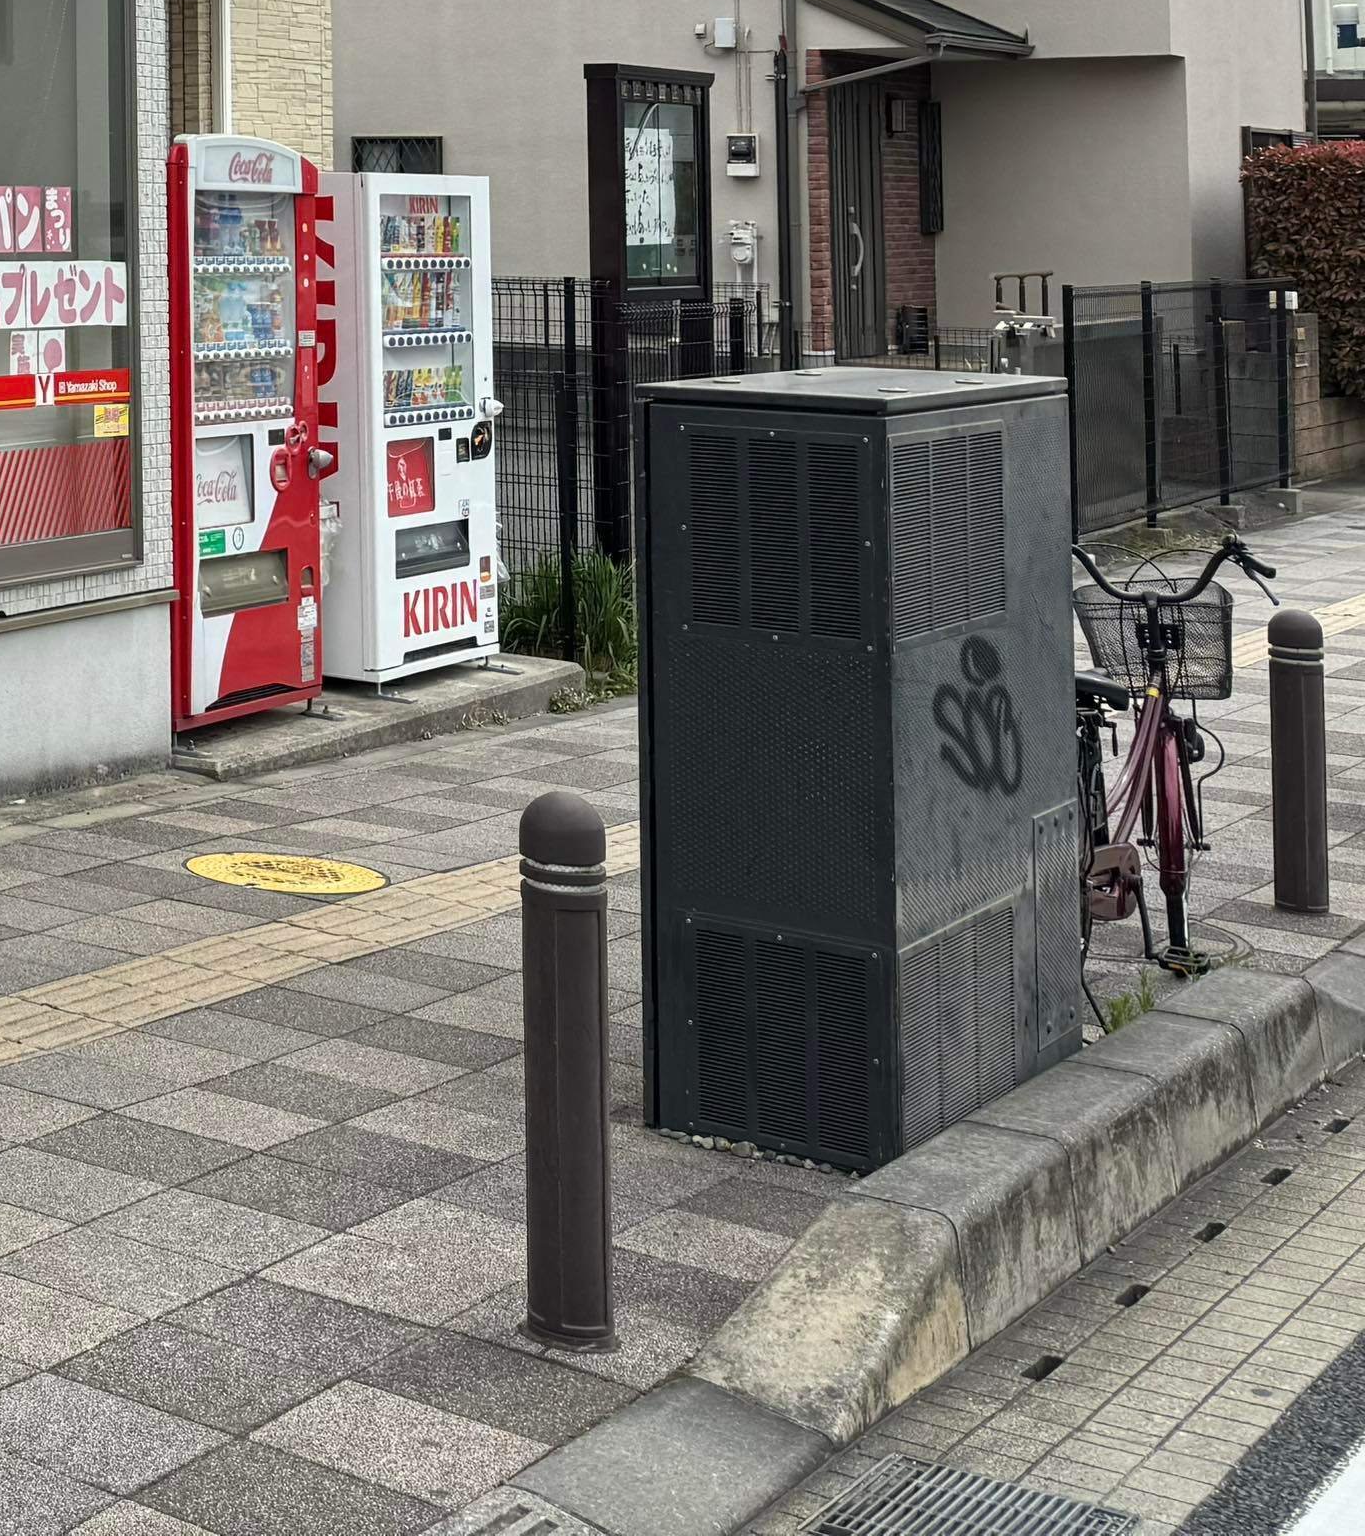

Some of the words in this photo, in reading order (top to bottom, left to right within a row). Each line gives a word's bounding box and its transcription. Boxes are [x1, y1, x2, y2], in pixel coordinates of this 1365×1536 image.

[408, 196, 439, 214] KIRIN
[38, 375, 51, 404] Y
[66, 380, 98, 393] Yamazaki
[99, 379, 118, 391] Shop
[403, 578, 478, 638] KIRIN
